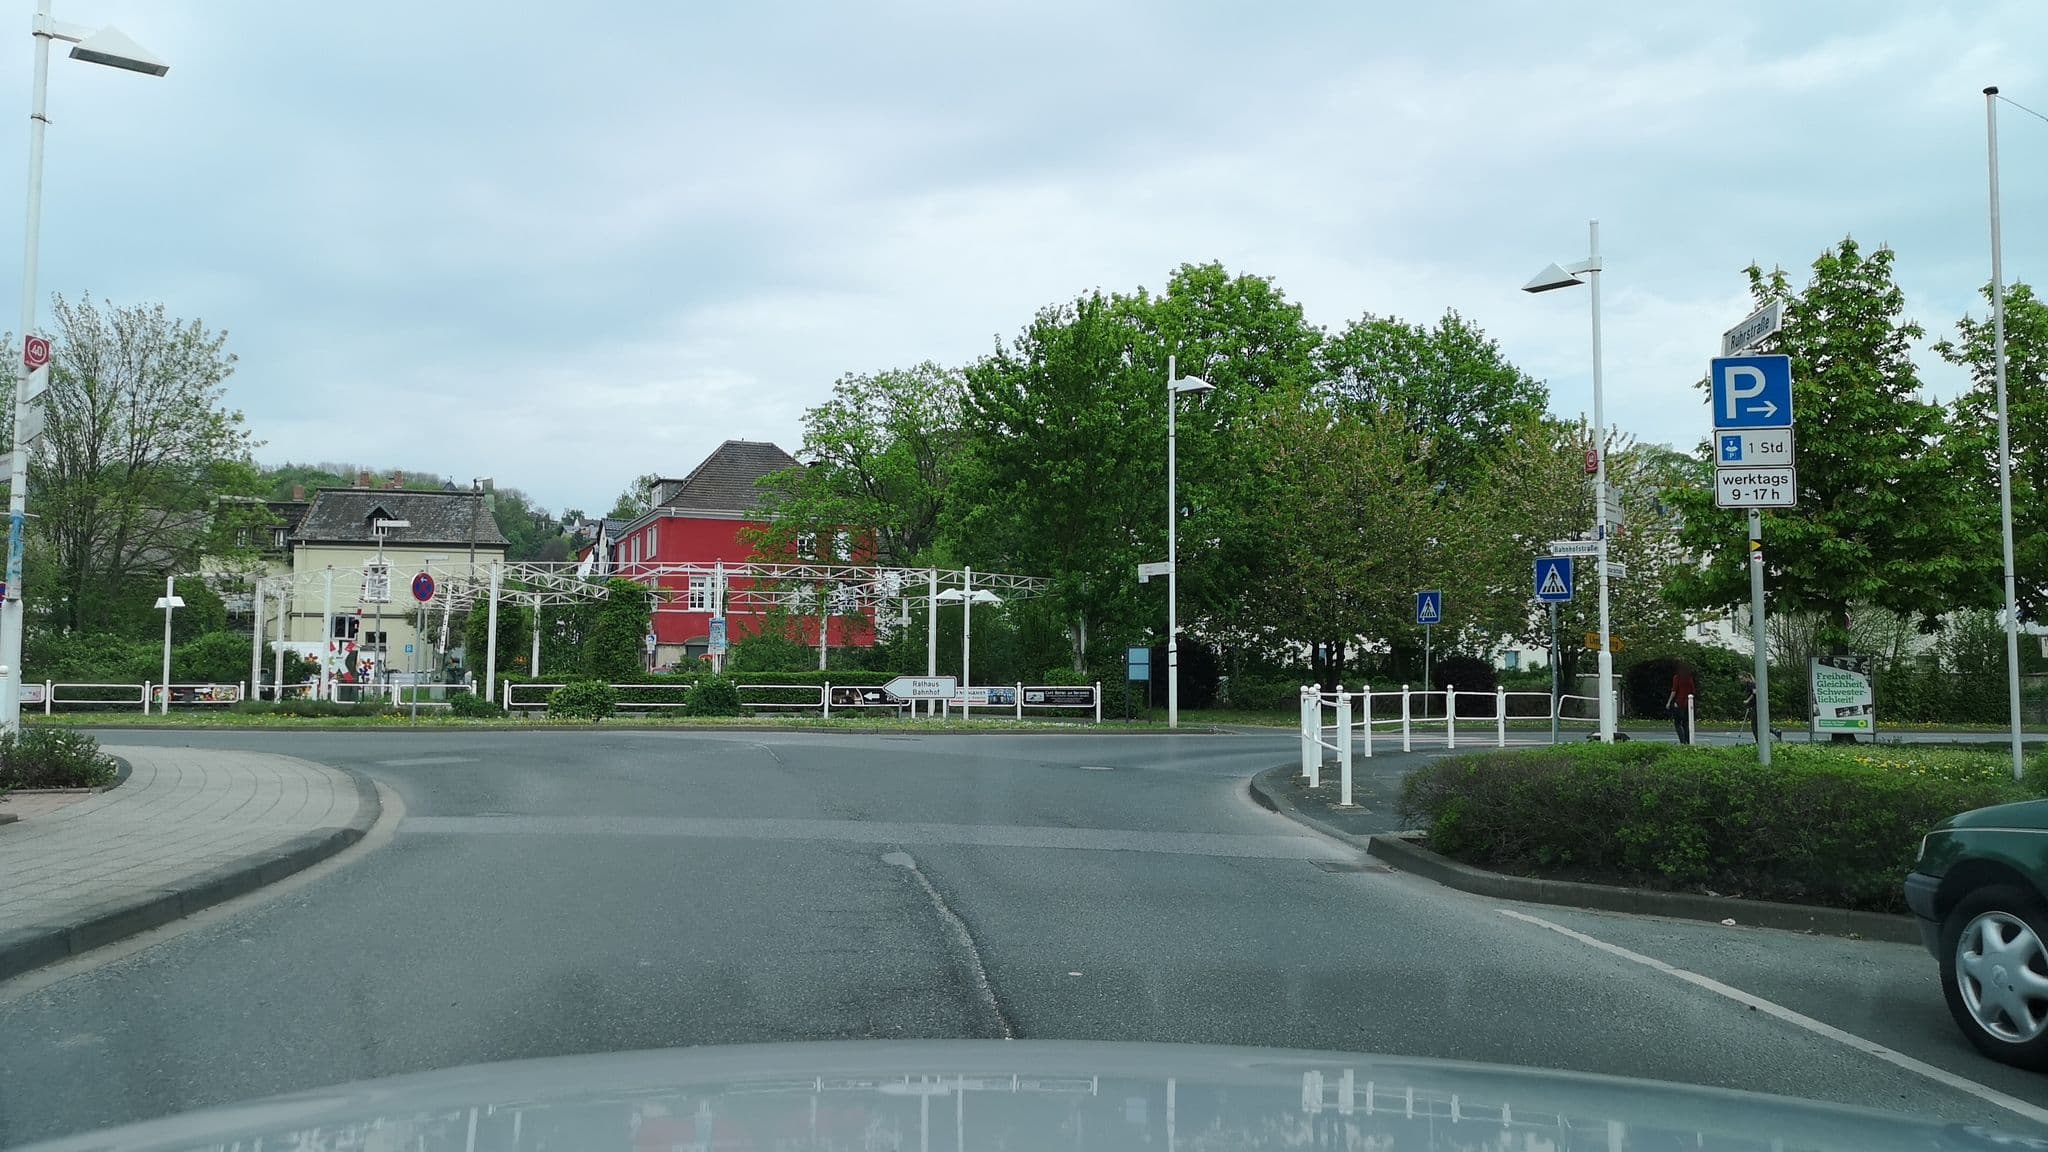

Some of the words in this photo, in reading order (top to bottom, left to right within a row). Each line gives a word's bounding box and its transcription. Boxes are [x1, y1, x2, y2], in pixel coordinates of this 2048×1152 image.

[1730, 316, 1770, 350] Ruhrstraße
[1724, 365, 1766, 420] P
[1748, 442, 1754, 454] 1
[1760, 441, 1788, 454] Std.
[1722, 473, 1789, 487] werktags
[1731, 488, 1741, 501] 9
[1752, 488, 1767, 500] 17
[1771, 488, 1780, 500] h
[1554, 544, 1598, 553] Bahnhofstraße
[1816, 672, 1853, 681] Freiheit,
[912, 680, 940, 688] Rathaus
[1816, 680, 1865, 689] Gleichheit,
[912, 688, 940, 696] Bahnhof
[1816, 688, 1868, 696] Schwester-
[1817, 695, 1854, 704] lichkeit!
